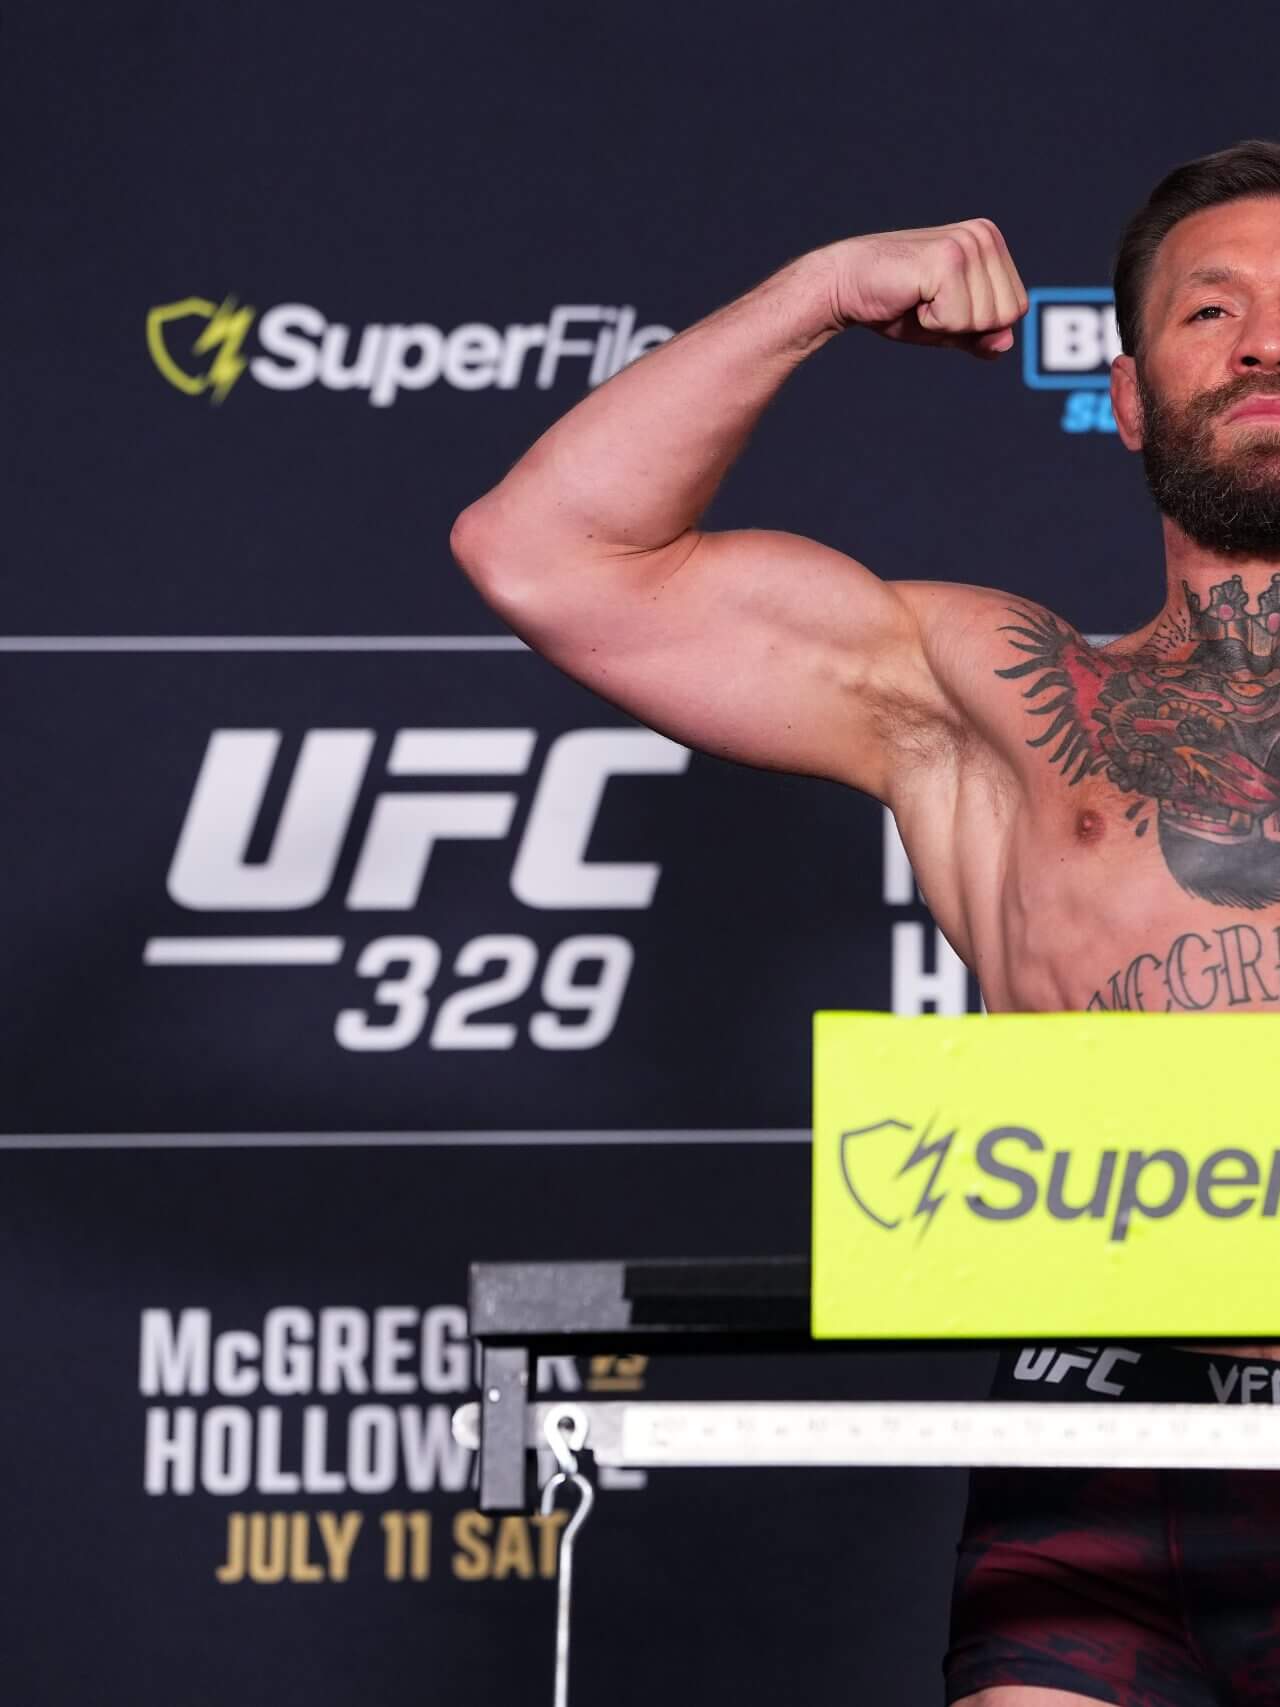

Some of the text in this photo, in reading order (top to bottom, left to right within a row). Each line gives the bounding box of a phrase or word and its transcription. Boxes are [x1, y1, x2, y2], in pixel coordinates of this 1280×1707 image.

[166, 728, 690, 911] UFC
[334, 934, 635, 1052] 329
[1013, 1346, 1141, 1396] UFC
[216, 1508, 568, 1583] JULY 11 SAT
